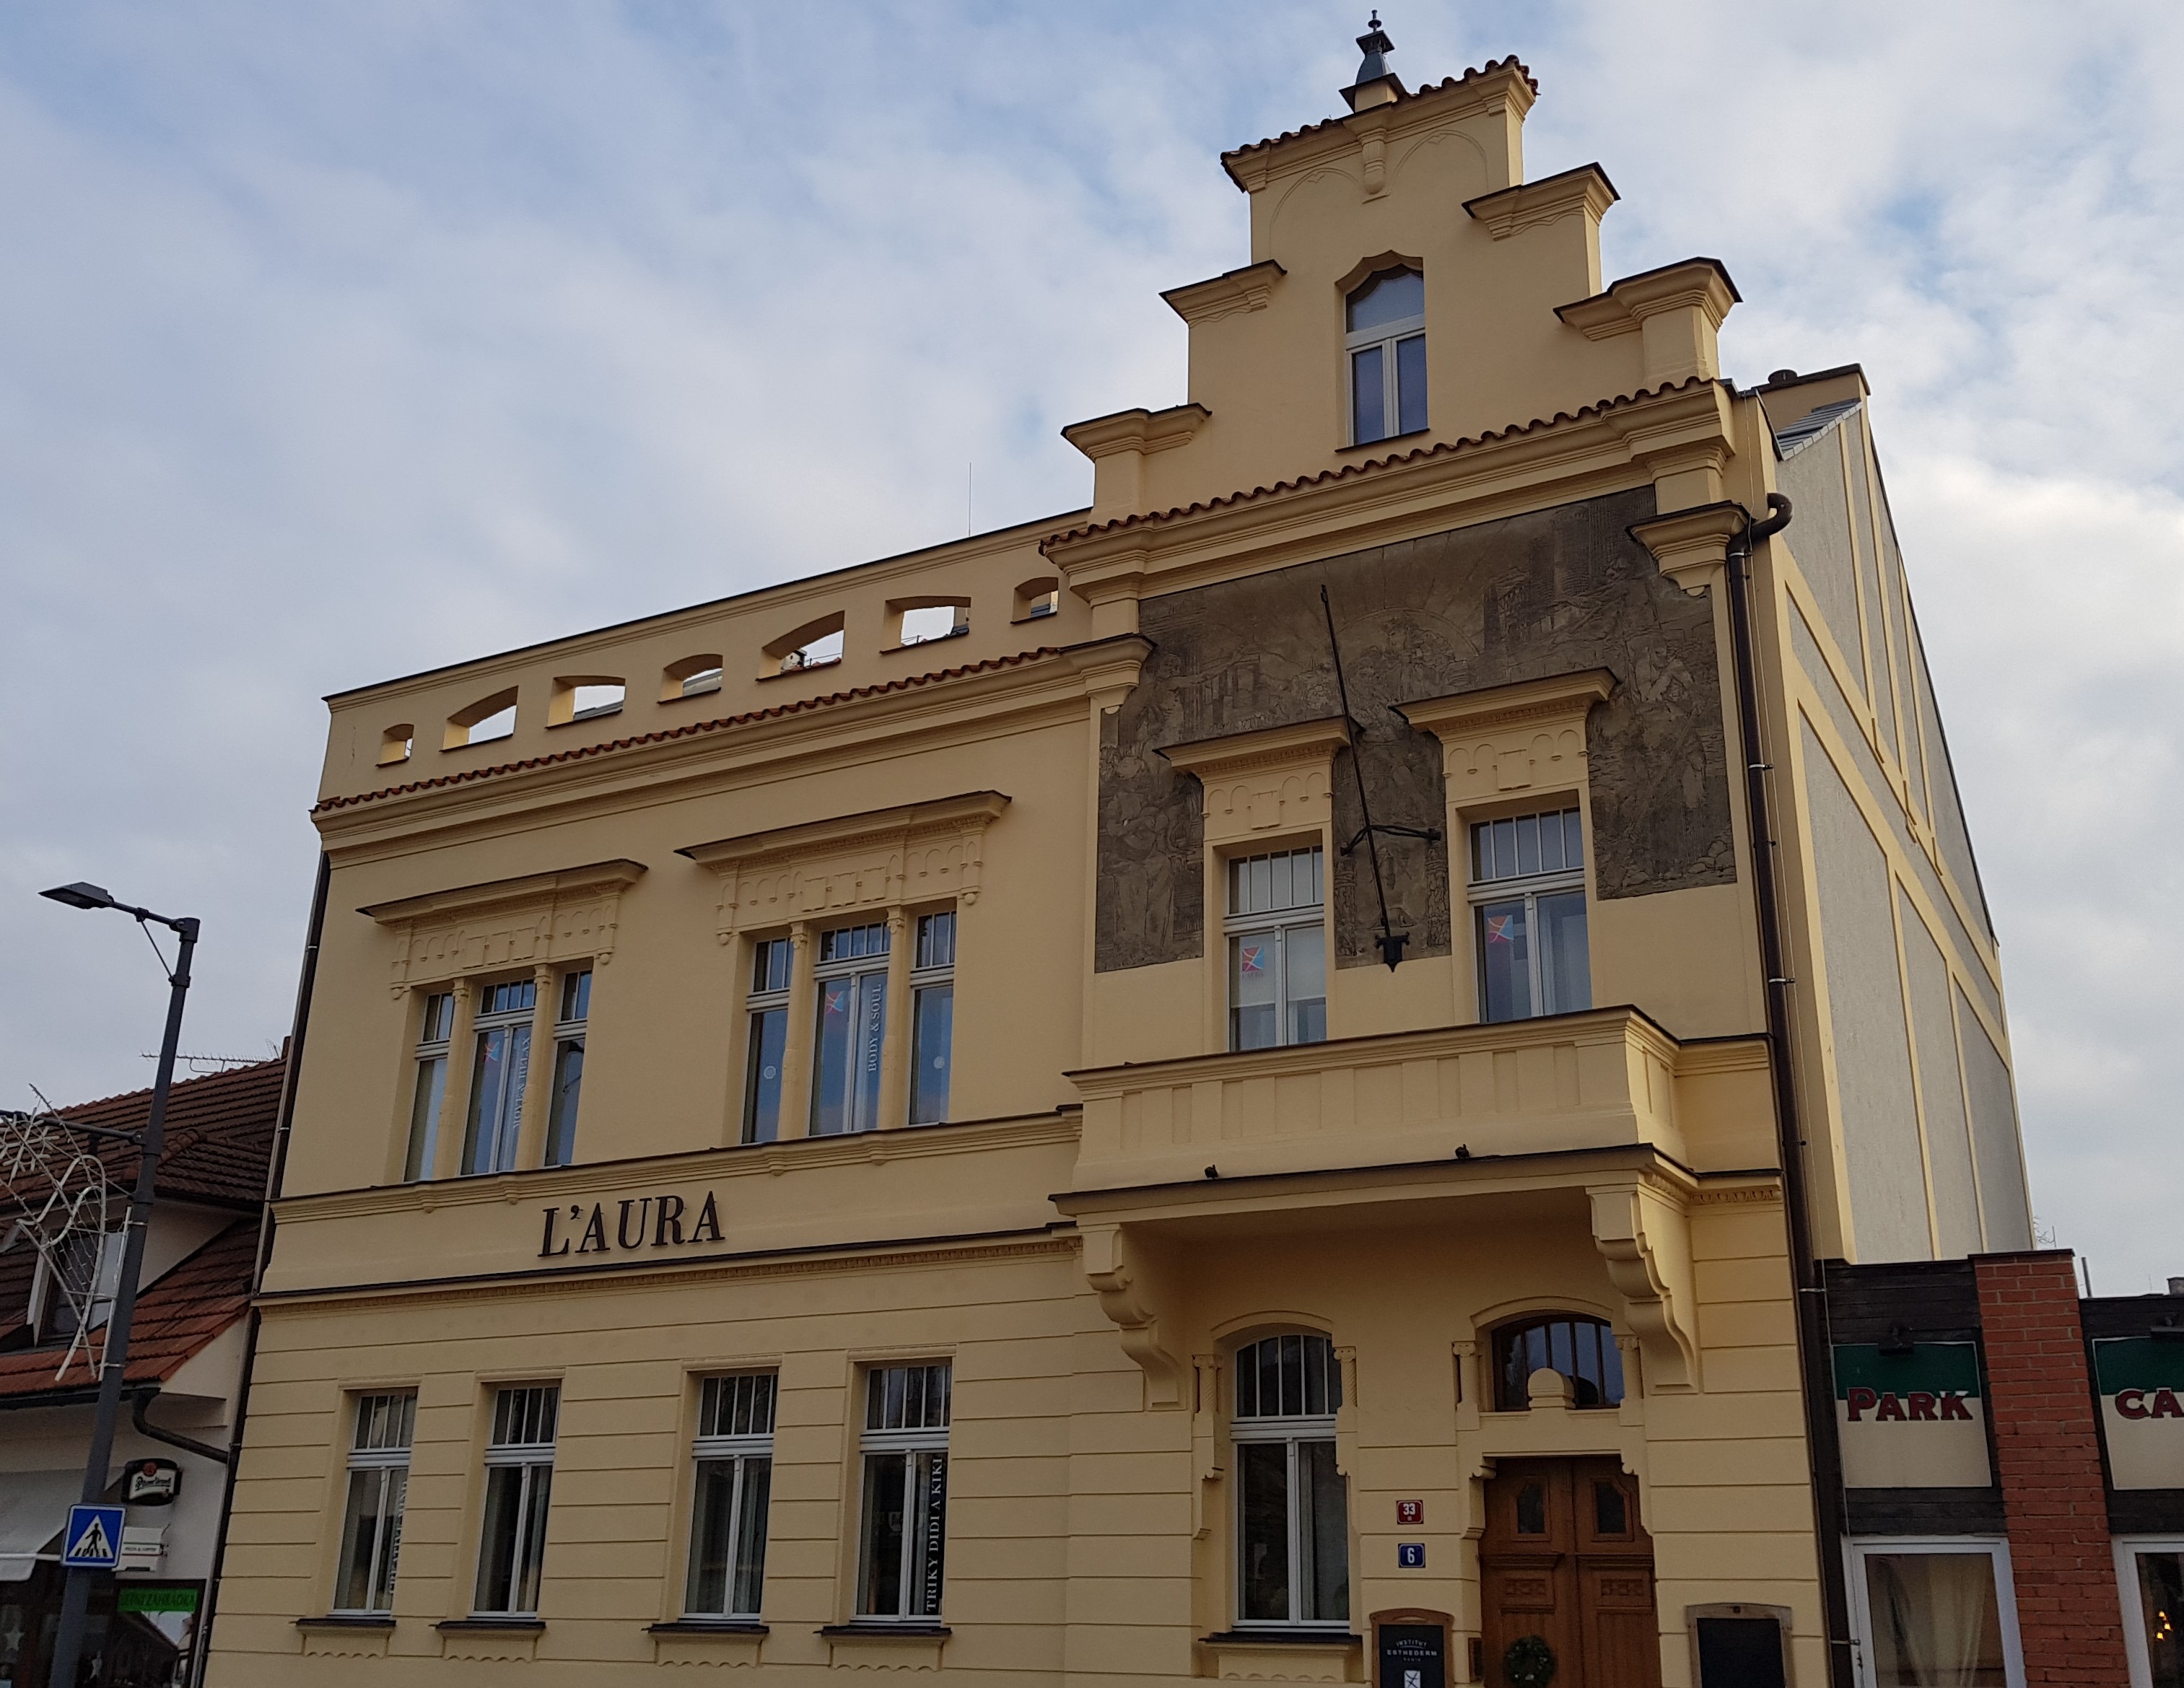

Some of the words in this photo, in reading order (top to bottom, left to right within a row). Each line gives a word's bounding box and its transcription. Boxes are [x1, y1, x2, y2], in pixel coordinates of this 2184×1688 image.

[871, 984, 883, 1020] SOUL
[870, 1022, 880, 1032] &
[868, 1037, 879, 1072] BODY
[539, 1190, 726, 1257] L'AURA
[1847, 1386, 1973, 1422] PARK
[2115, 1386, 2184, 1420] CA
[931, 1458, 943, 1495] KIKI
[931, 1500, 941, 1510] A
[1402, 1503, 1416, 1516] 33
[929, 1516, 940, 1552] DIDI
[1407, 1547, 1415, 1564] 6
[927, 1557, 938, 1612] TRIKY
